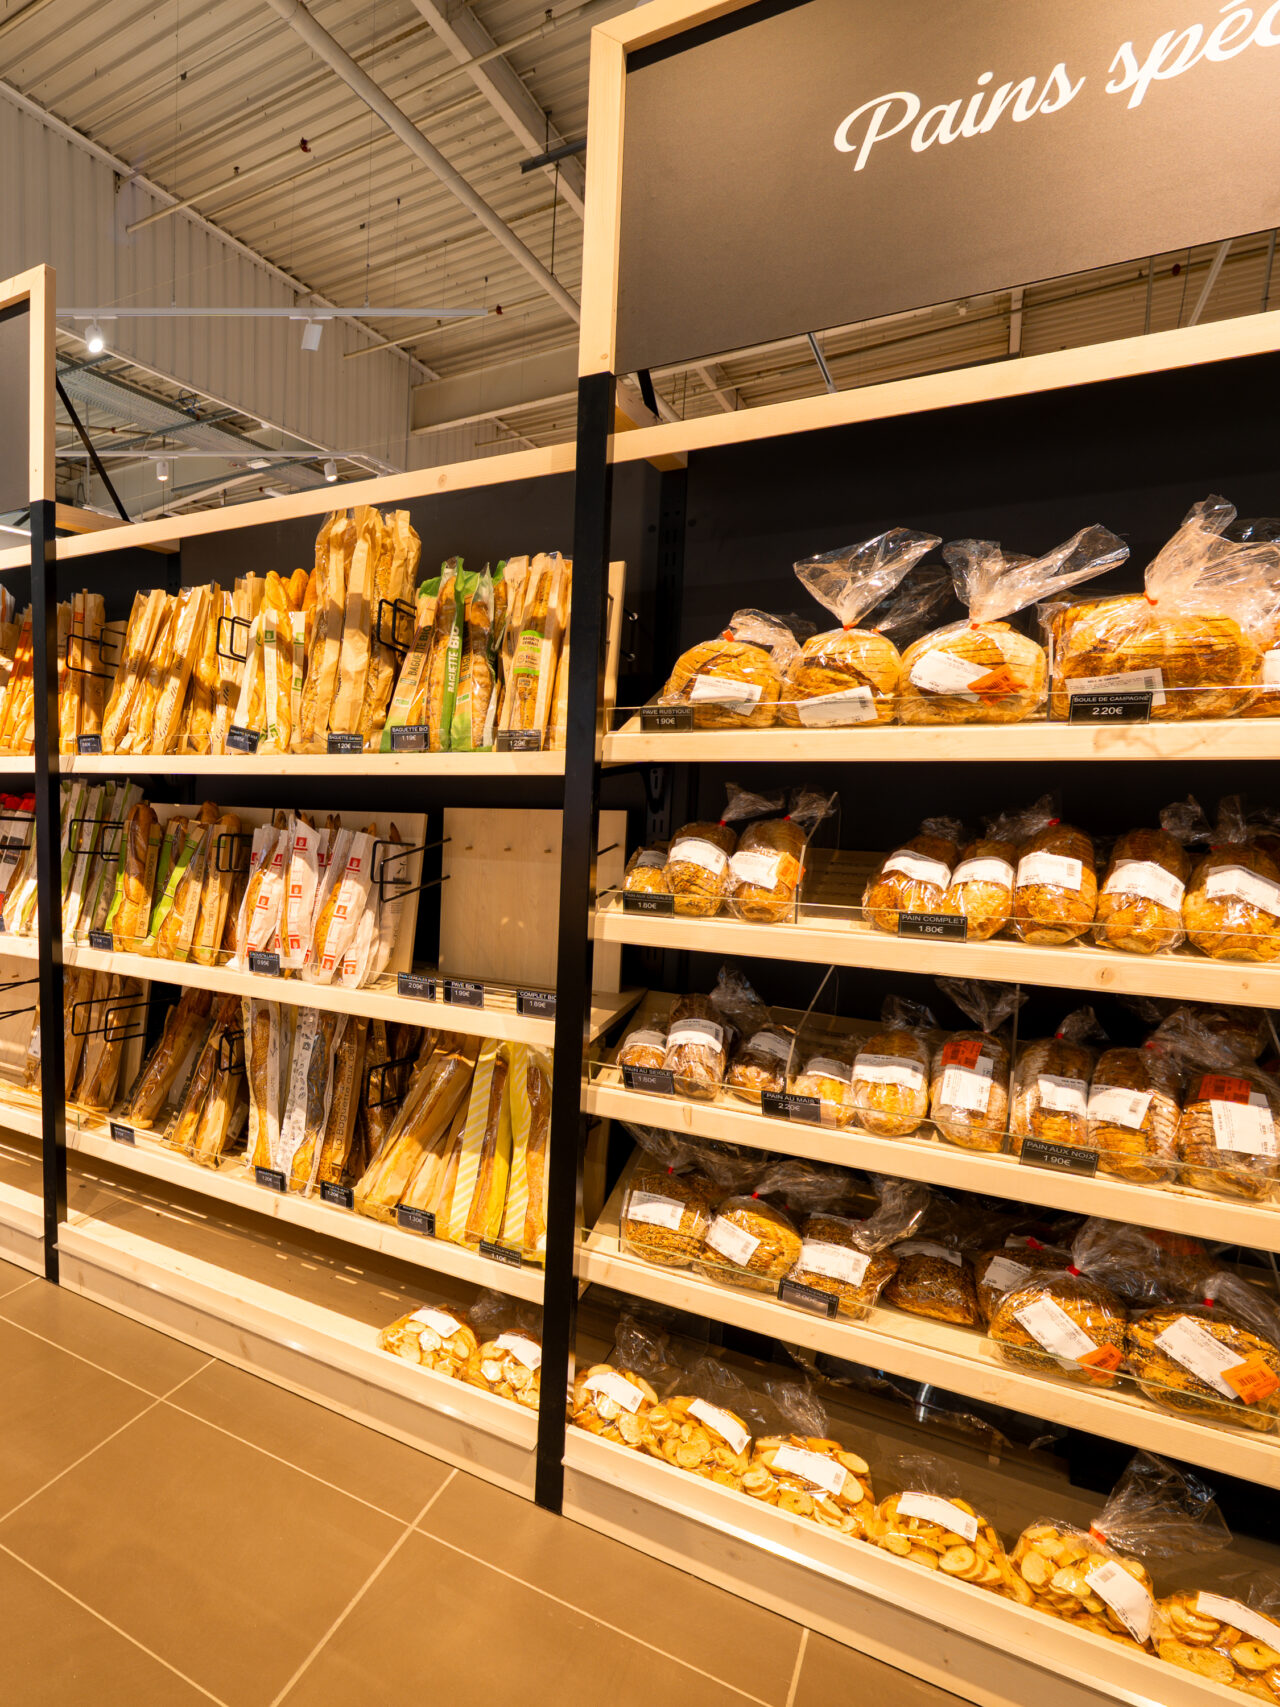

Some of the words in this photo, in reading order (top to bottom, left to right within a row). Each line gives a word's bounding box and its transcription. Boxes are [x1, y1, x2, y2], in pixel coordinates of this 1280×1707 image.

[833, 61, 1086, 172] Pains
[419, 625, 432, 641] BIO
[449, 625, 460, 649] BIO
[447, 651, 459, 693] BAGUETTE
[1073, 695, 1097, 703] BOULE
[901, 914, 921, 922] PAIN
[923, 916, 965, 925] COMPLET
[519, 991, 546, 999] COMPLET
[649, 1069, 671, 1077] SEIGLE
[766, 1092, 783, 1100] PAIN
[1026, 1141, 1047, 1151] PAIN
[1049, 1146, 1069, 1156] AUX
[1071, 1150, 1096, 1161] NOIX
